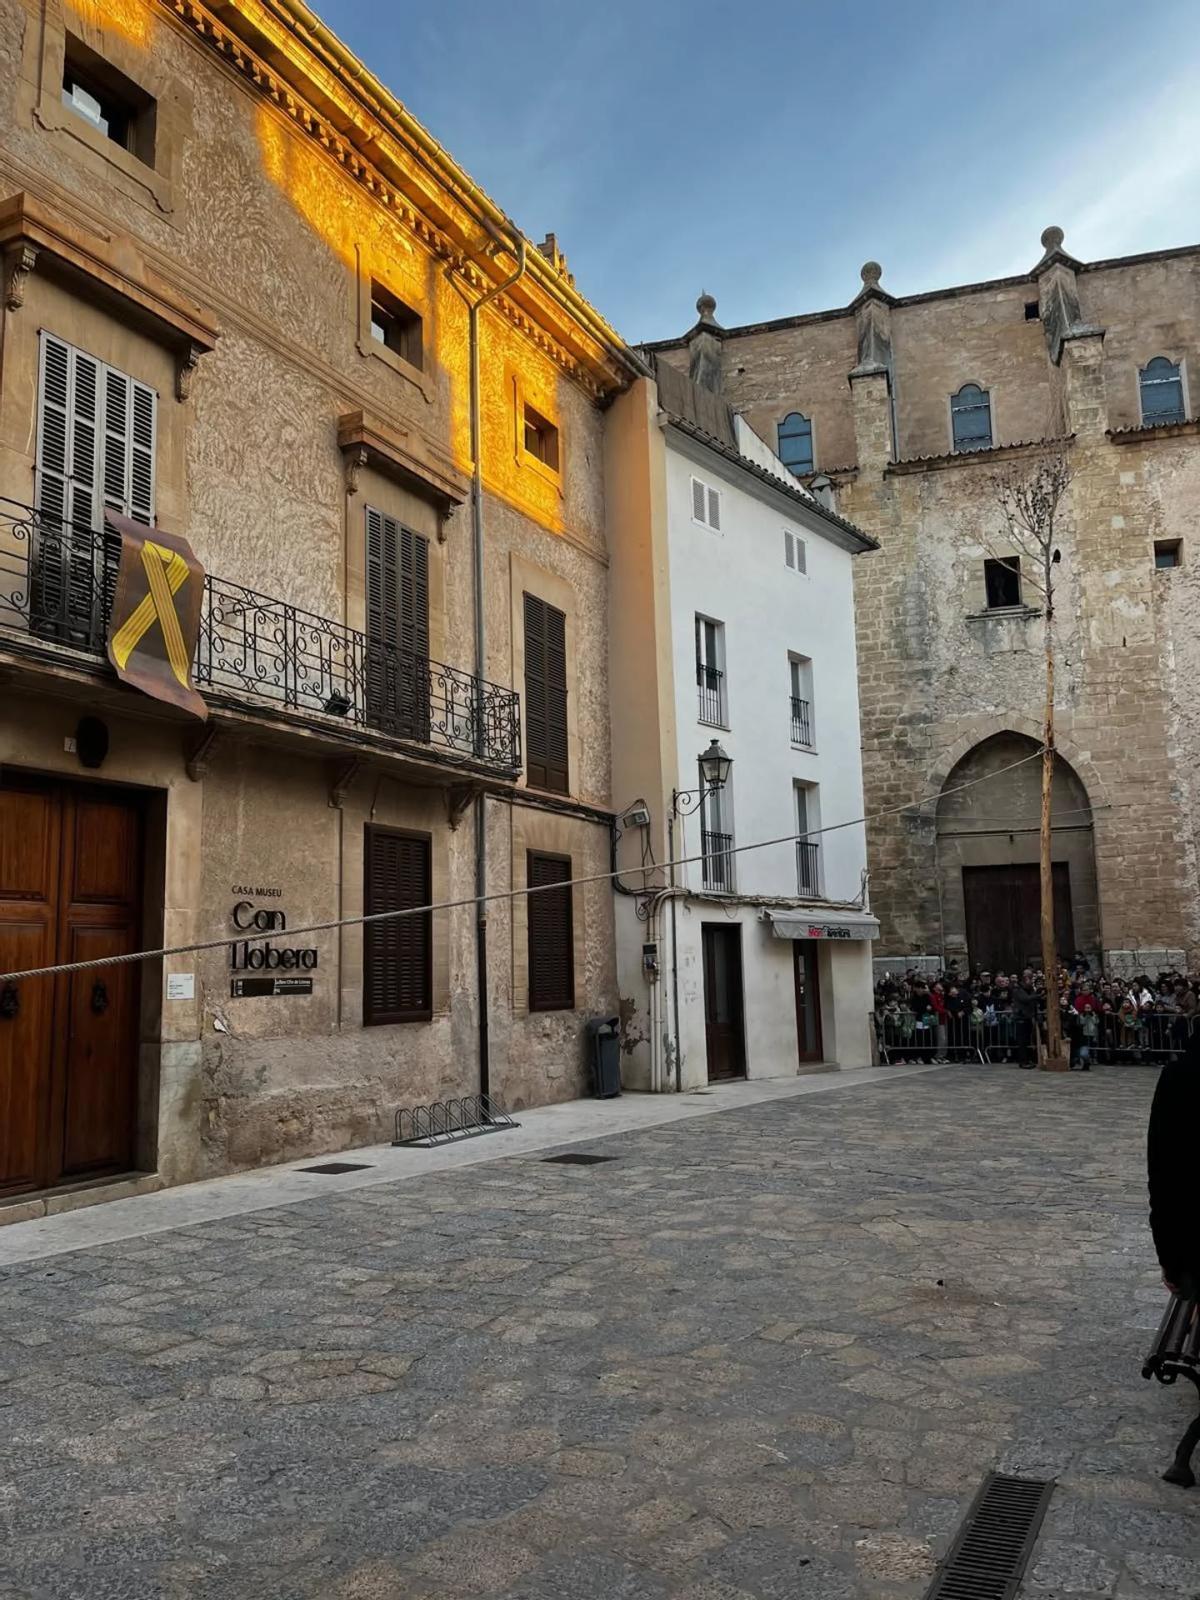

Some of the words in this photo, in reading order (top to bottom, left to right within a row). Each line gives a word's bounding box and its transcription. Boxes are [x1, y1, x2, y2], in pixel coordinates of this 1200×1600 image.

[231, 885, 254, 896] CASA
[255, 887, 282, 898] MUSEU
[233, 901, 286, 931] Can
